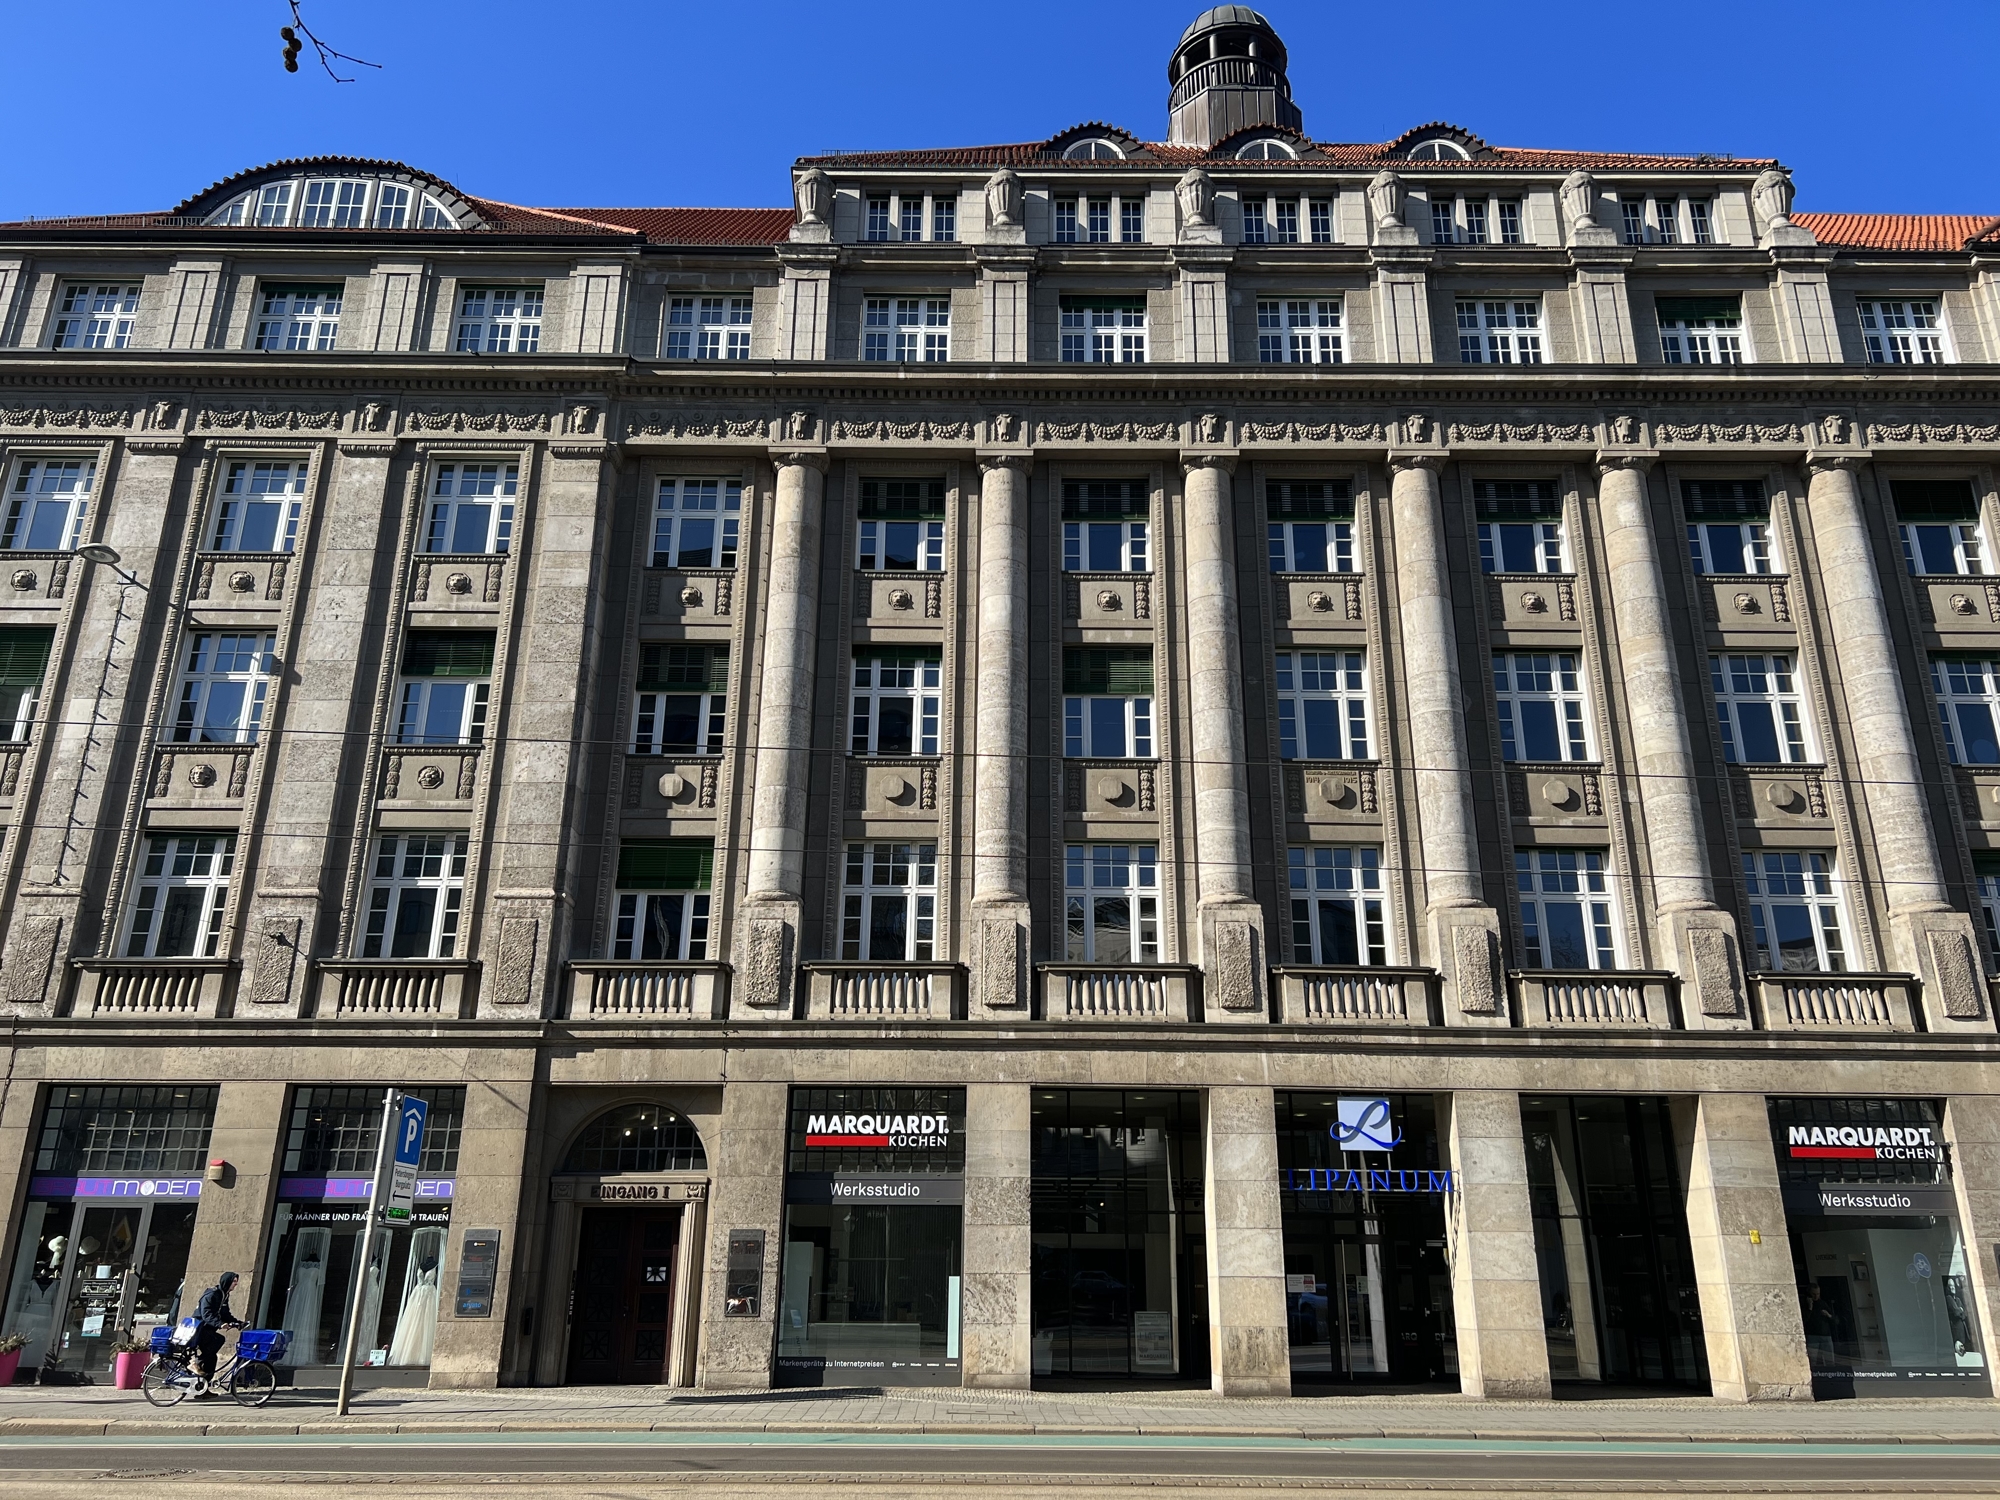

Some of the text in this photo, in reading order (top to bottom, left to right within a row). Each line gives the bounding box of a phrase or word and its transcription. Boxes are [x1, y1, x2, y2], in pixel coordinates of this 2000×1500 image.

[404, 1117, 418, 1154] P
[888, 1135, 947, 1147] KÜCHEN
[1875, 1147, 1936, 1159] KÜCHEN
[1286, 1168, 1454, 1193] LIPANUM
[591, 1185, 658, 1199] EINGANG
[830, 1182, 920, 1197] Werksstudio
[1818, 1193, 1911, 1207] Werksstudio
[279, 1213, 293, 1221] FÜR
[295, 1212, 330, 1221] MÄNNER
[332, 1213, 350, 1221] UND
[418, 1213, 449, 1221] TRAUEN
[779, 1359, 824, 1368] Markengeräte
[834, 1360, 885, 1368] Internetpreisen
[1812, 1371, 1846, 1379] arkengeräte
[1854, 1371, 1897, 1379] Internetpreisen
